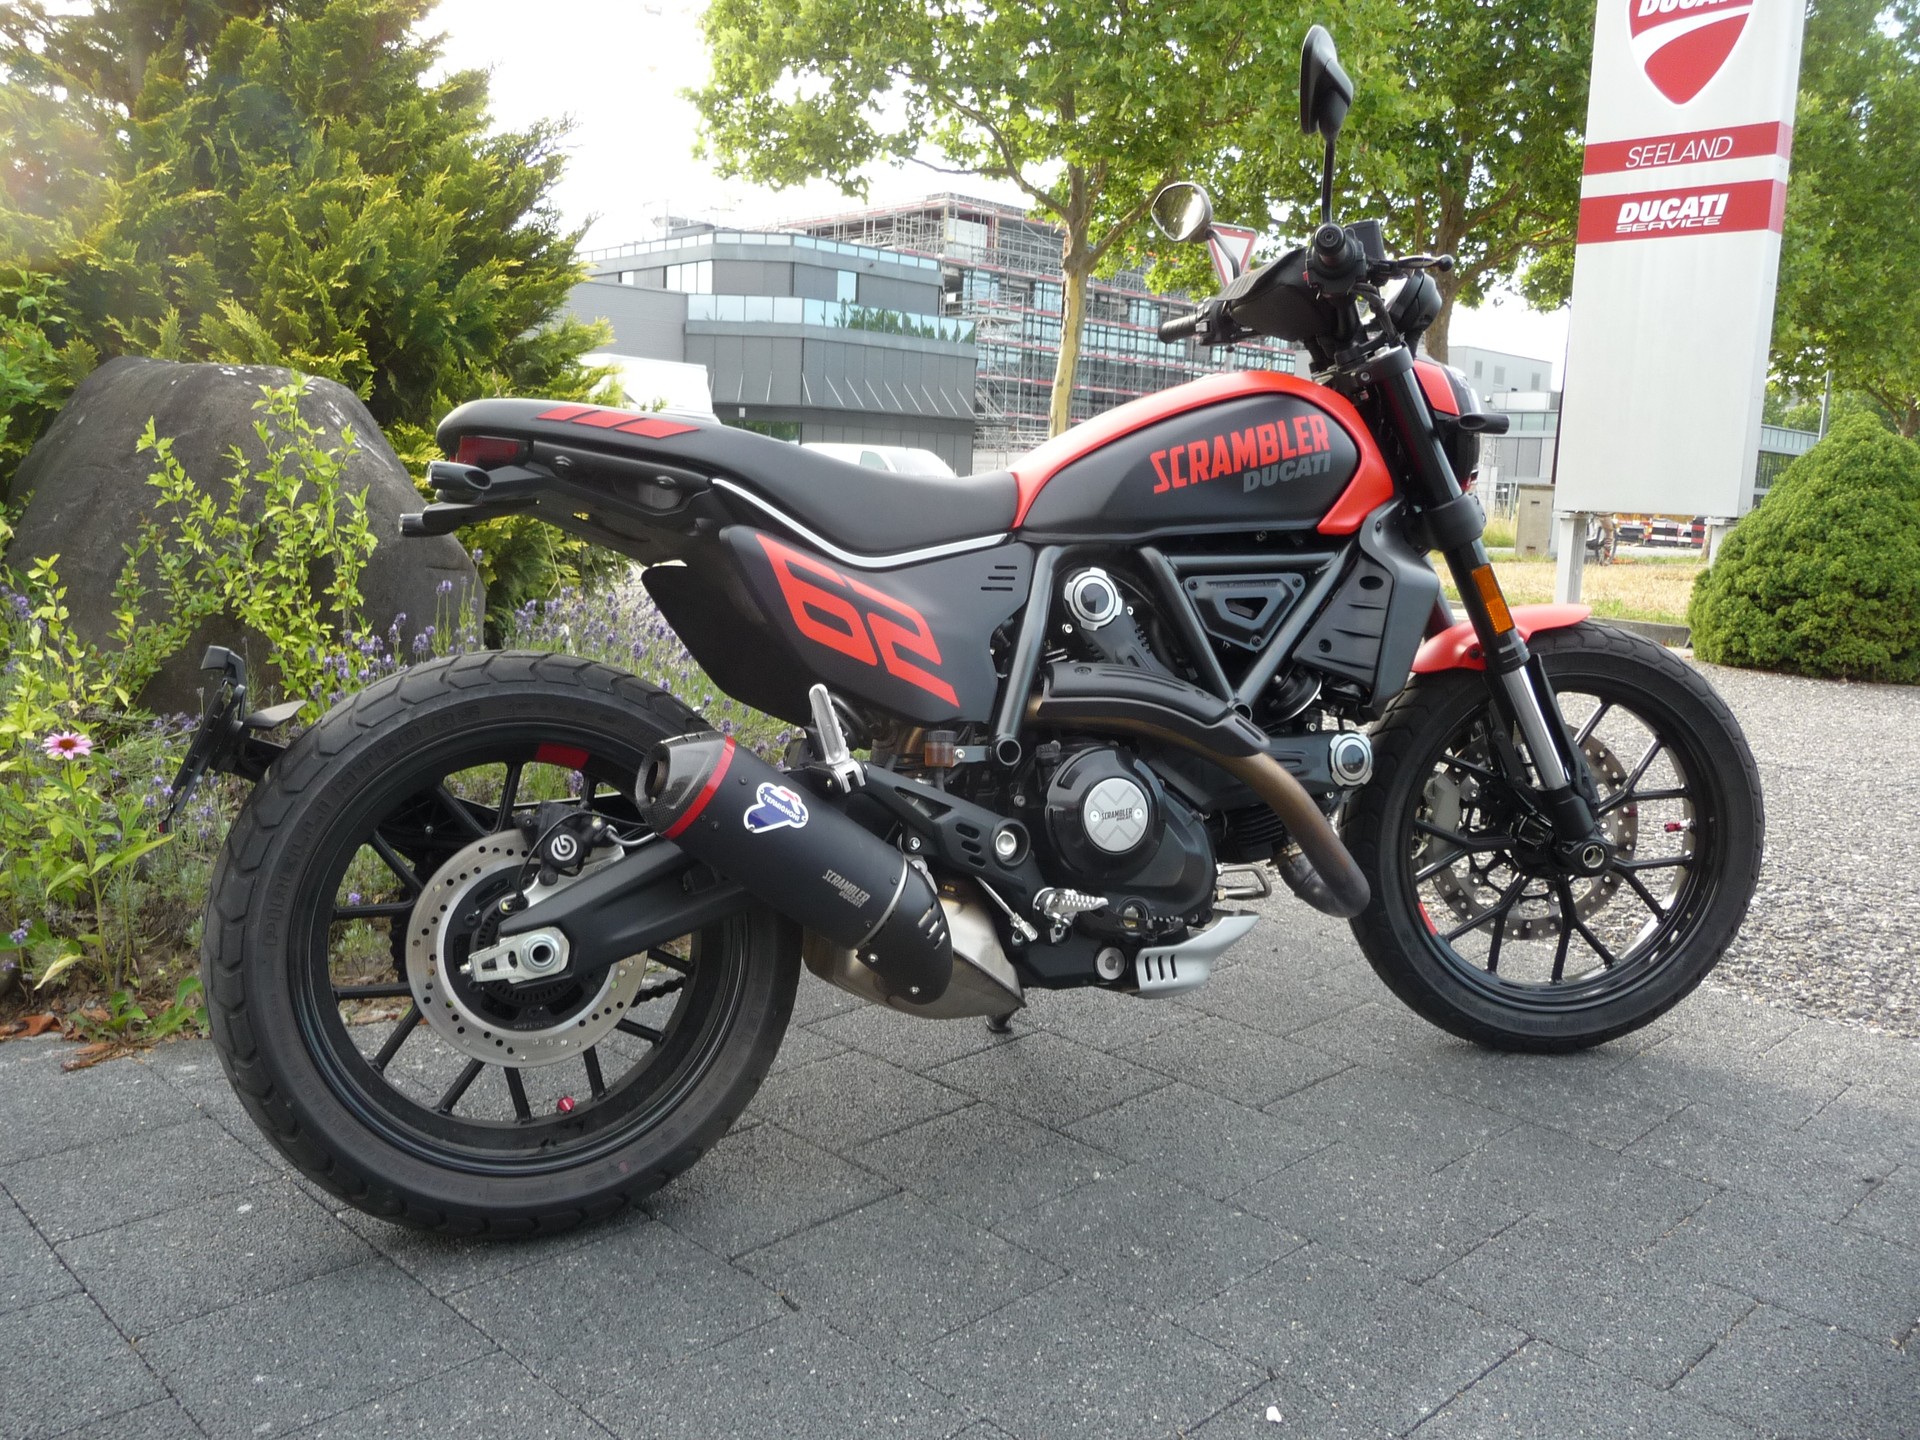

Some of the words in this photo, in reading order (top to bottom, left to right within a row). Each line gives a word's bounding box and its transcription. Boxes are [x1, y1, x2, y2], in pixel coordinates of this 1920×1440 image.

[1625, 136, 1733, 168] SEELAND
[1617, 193, 1729, 224] DUCATI
[1615, 216, 1722, 233] SERVICE
[1150, 415, 1331, 494] SCRAMBLER
[1243, 453, 1332, 493] DUCATI
[755, 533, 960, 708] 62
[763, 794, 800, 822] TERMIGNONI
[1102, 807, 1133, 820] SCRAMBLER
[822, 869, 871, 902] SCRAMBLER
[838, 890, 864, 908] DUCATI
